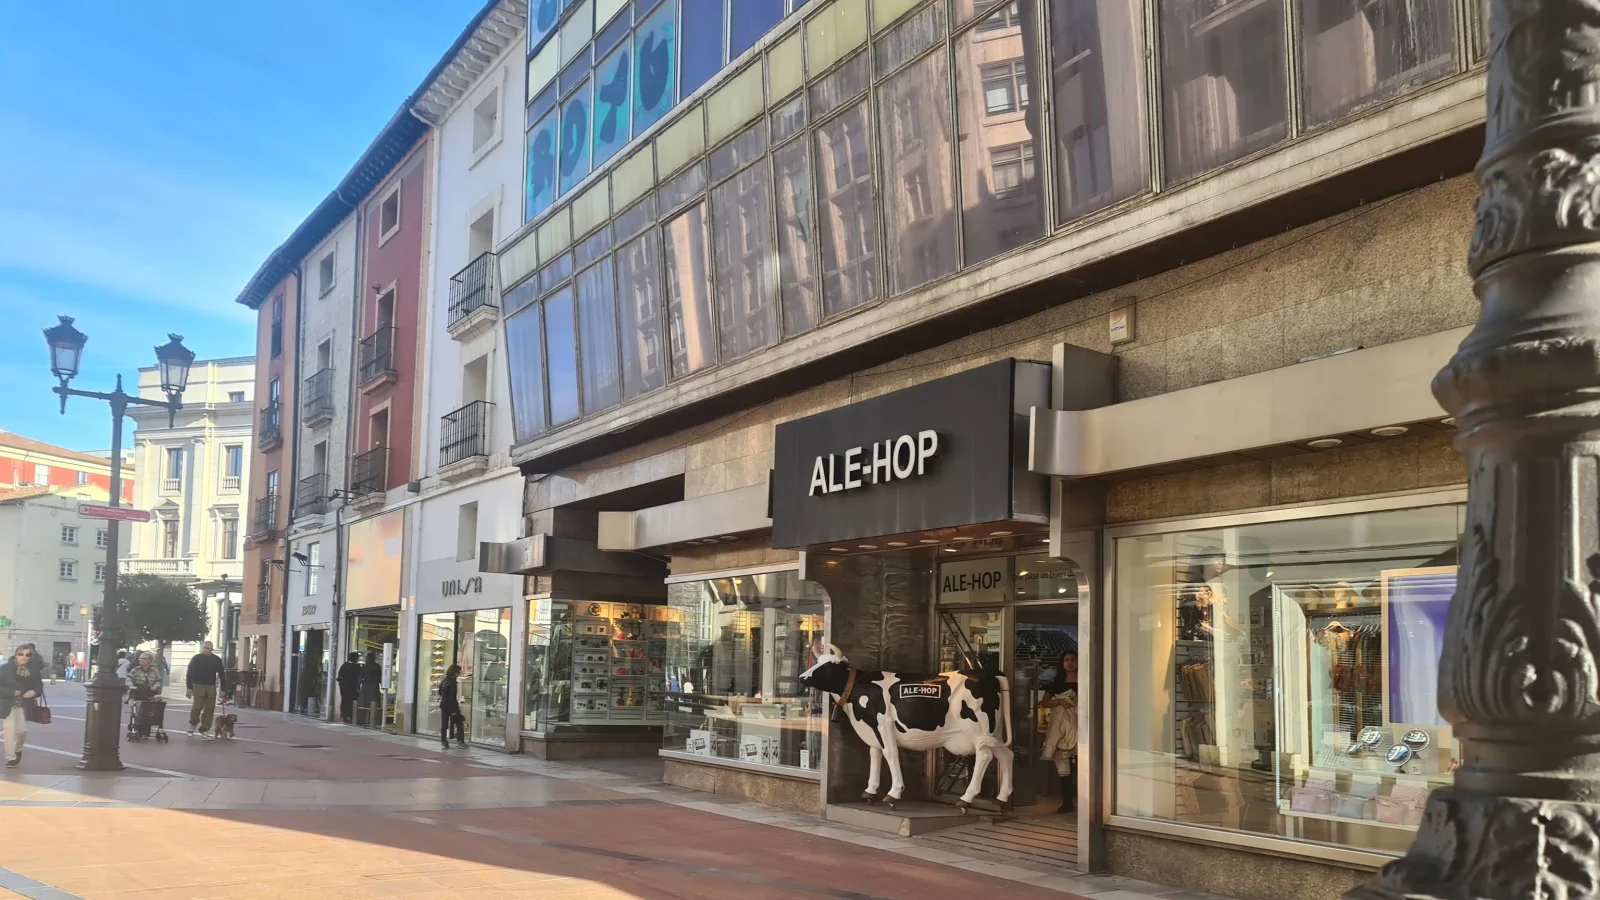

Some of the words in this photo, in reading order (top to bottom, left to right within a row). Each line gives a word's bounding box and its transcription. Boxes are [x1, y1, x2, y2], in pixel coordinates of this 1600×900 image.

[808, 429, 938, 497] ALE-HOP
[943, 571, 1001, 592] ALE-HOP
[903, 686, 938, 695] ALE-HOP
